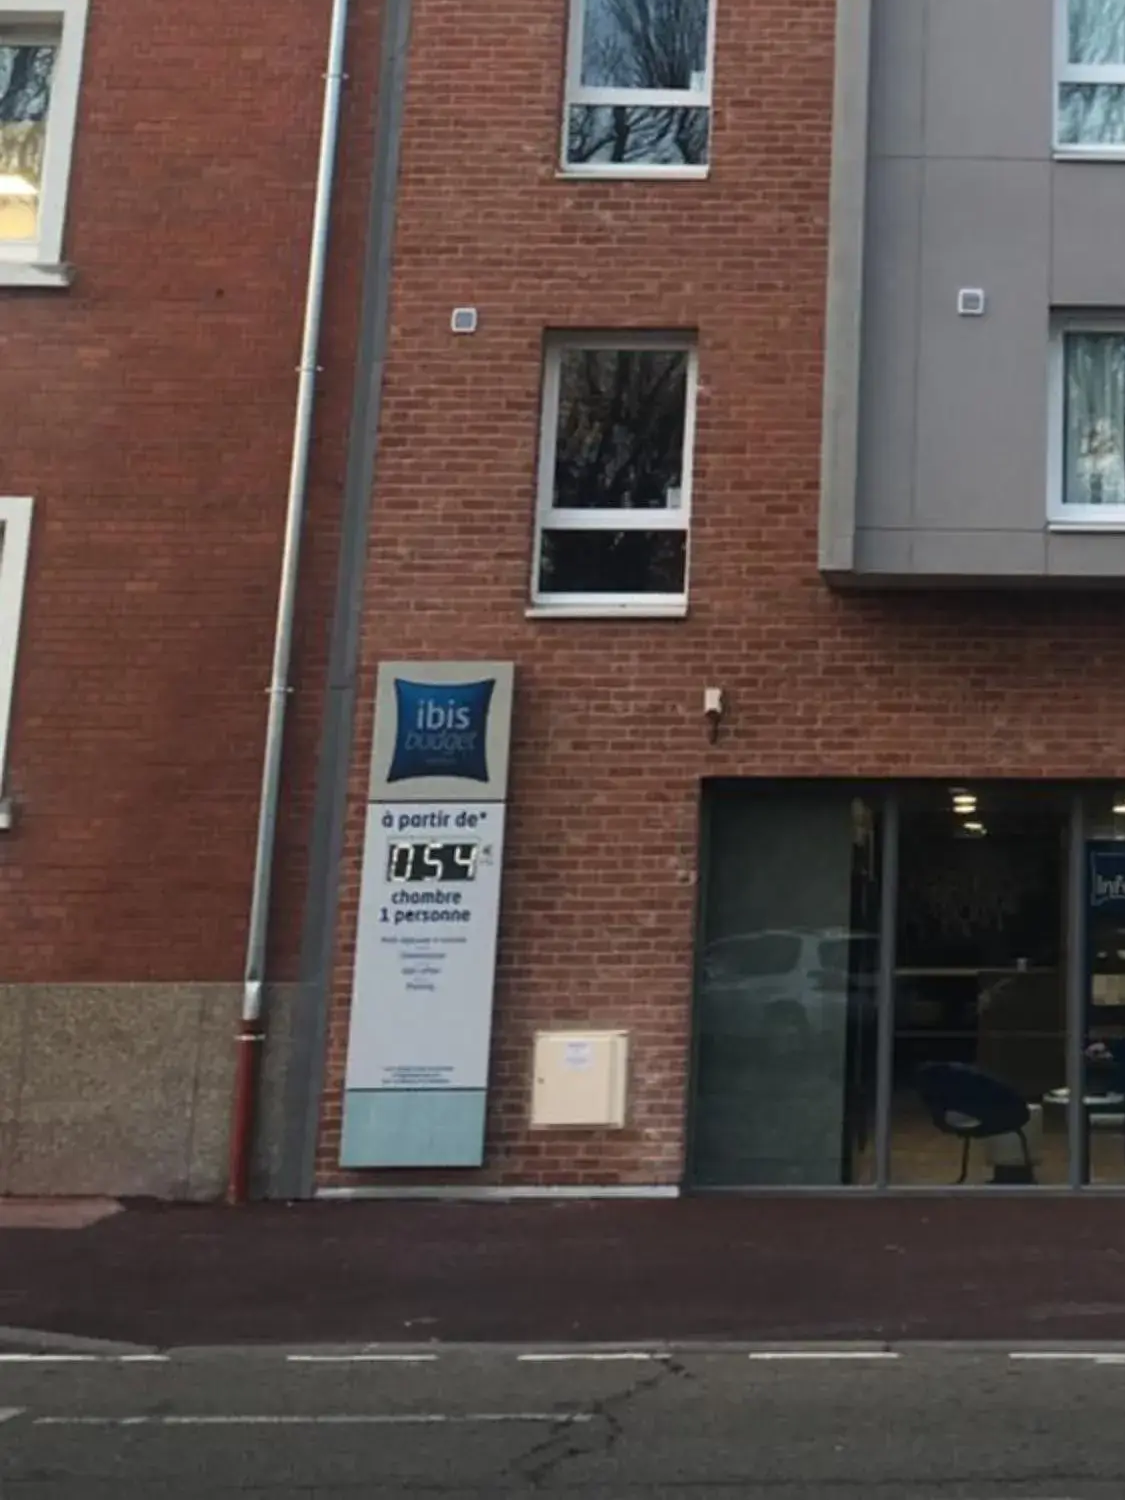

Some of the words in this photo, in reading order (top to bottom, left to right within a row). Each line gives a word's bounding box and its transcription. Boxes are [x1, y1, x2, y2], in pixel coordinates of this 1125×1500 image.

[416, 697, 471, 731] ibis
[404, 729, 478, 757] budget
[398, 809, 452, 832] partir
[391, 887, 463, 905] chambre
[379, 906, 390, 923] 1
[394, 908, 472, 926] personne
